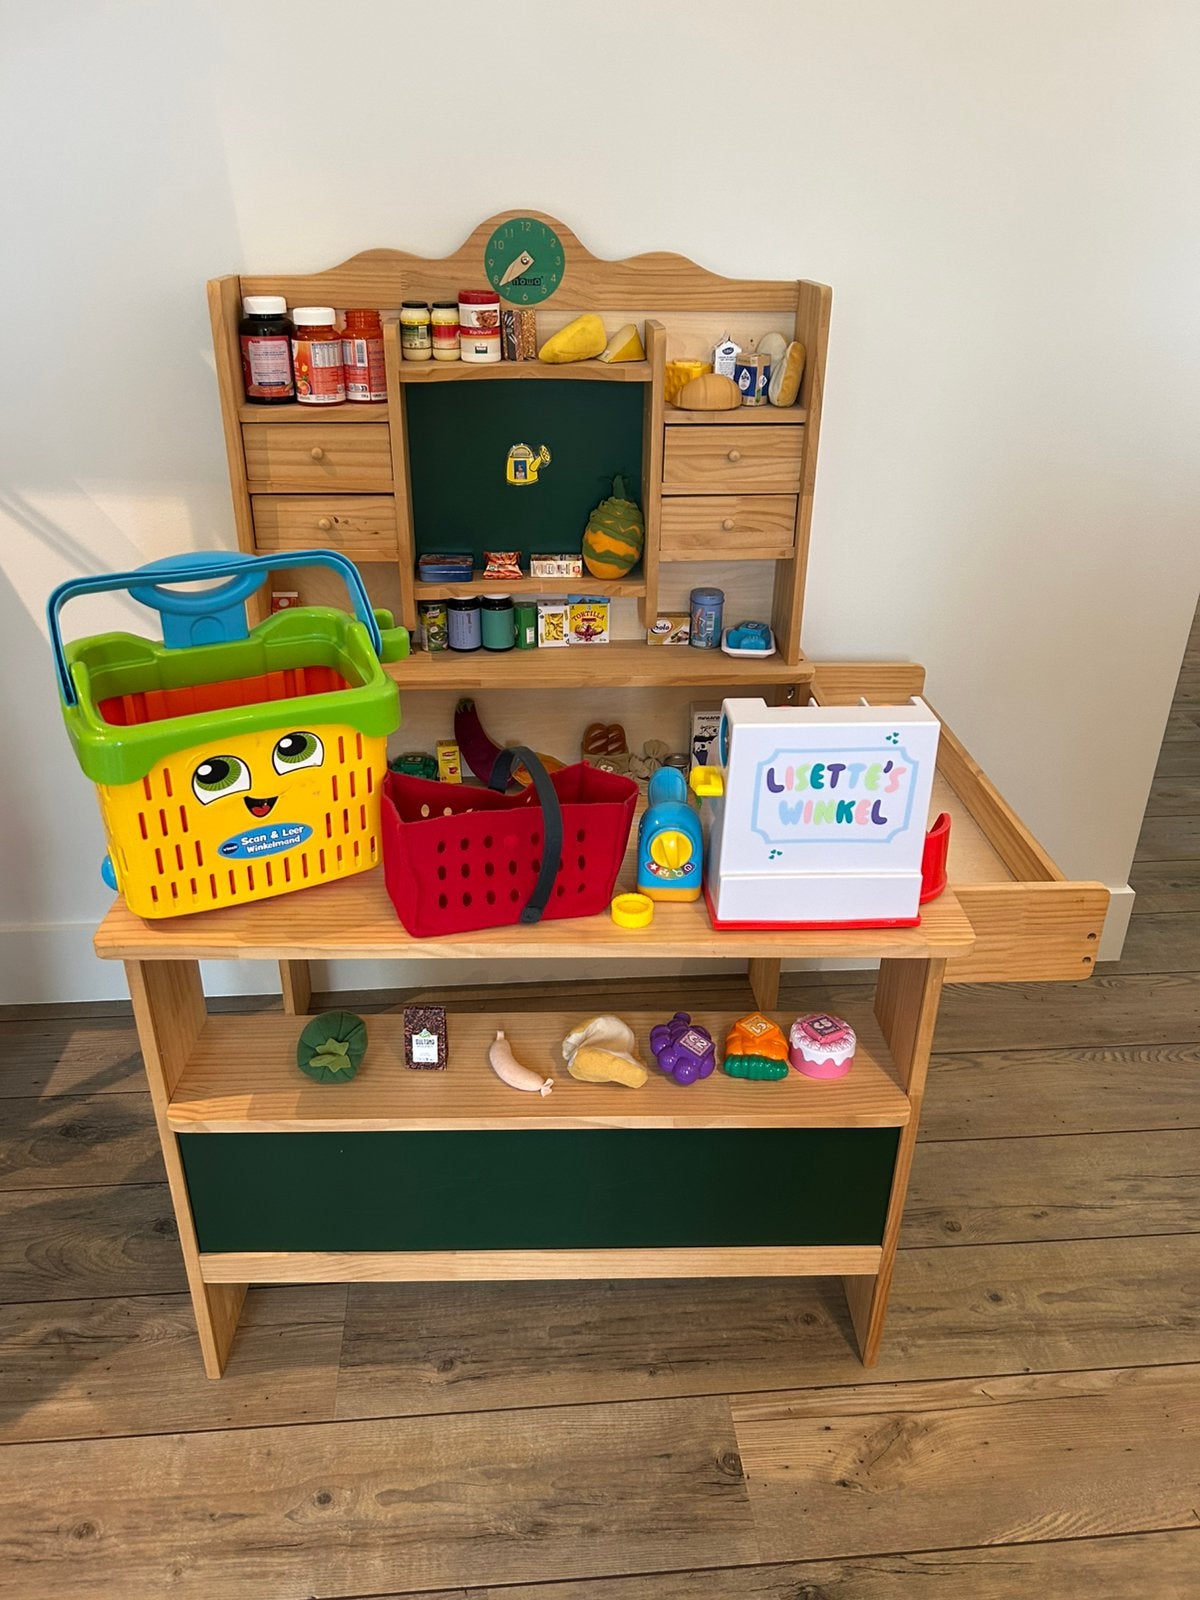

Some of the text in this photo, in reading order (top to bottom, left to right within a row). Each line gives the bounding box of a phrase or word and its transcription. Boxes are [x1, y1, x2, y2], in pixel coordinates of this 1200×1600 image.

[520, 221, 532, 232] 12
[504, 228, 514, 238] 11
[541, 228, 546, 238] 1
[493, 240, 505, 250] 10
[550, 238, 557, 248] 2
[488, 258, 495, 267] 9
[554, 256, 561, 266] 3
[493, 275, 500, 285] 8
[550, 274, 557, 283] 4
[505, 287, 511, 296] 7
[541, 285, 548, 294] 5
[522, 293, 529, 301] 6
[571, 610, 605, 622] TORTILLA
[766, 760, 907, 794] LISETTE'S
[778, 799, 888, 826] WINKEL
[241, 826, 304, 846] Scan & Leer
[246, 835, 301, 853] Winkelmand
